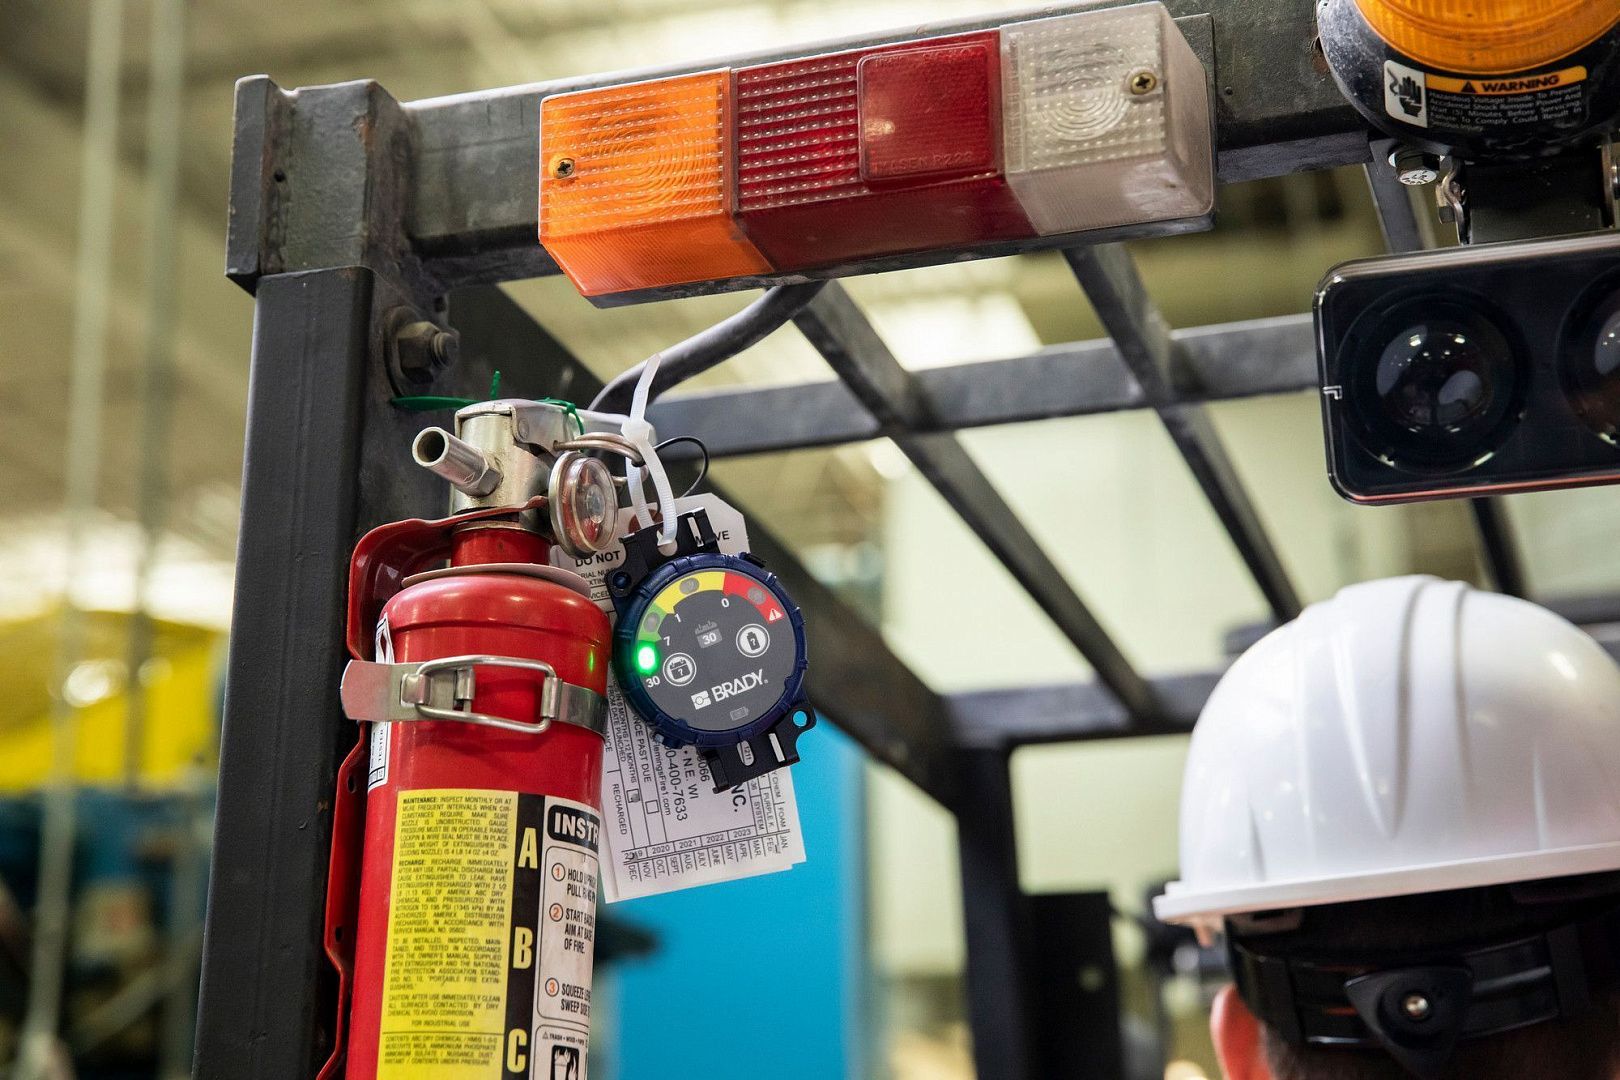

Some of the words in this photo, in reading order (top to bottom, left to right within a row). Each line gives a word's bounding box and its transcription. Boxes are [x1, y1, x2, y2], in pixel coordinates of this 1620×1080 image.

[1481, 75, 1560, 92] WARNING
[596, 550, 621, 564] NOT
[721, 598, 730, 608] 0
[674, 613, 682, 623] 1
[664, 636, 671, 646] 7
[702, 632, 717, 646] 30
[646, 675, 661, 688] 30
[711, 668, 764, 702] BRADY
[611, 707, 619, 726] DATE
[614, 726, 626, 763] PUNCHED
[637, 739, 648, 761] PAST
[744, 745, 752, 760] 1211
[626, 751, 637, 783] MONTHS
[641, 763, 652, 782] DUE
[683, 756, 696, 782] N.E.
[688, 784, 699, 799] WI
[772, 776, 782, 798] CHEM
[731, 784, 747, 812] NC.
[763, 792, 774, 820] PURPLE
[613, 783, 627, 836] RECHARGED
[754, 801, 765, 830] SYSTEM
[778, 807, 786, 828] FOAM
[706, 833, 724, 843] 2022
[733, 828, 751, 838] 2023
[517, 827, 538, 869] A
[652, 844, 670, 854] 2020
[679, 839, 697, 849] 2021
[739, 842, 747, 858] APR
[753, 839, 762, 856] MAR
[698, 851, 707, 867] JULY
[711, 849, 720, 865] JUNE
[725, 845, 734, 860] MAY
[642, 861, 651, 878] NOV
[655, 859, 665, 874] OCT
[670, 856, 679, 873] SEPT
[684, 853, 693, 870] AUG
[567, 868, 583, 883] HOLD
[628, 864, 638, 880] DEC
[566, 883, 582, 898] PULL
[565, 908, 583, 921] START
[564, 923, 576, 936] AIM
[576, 926, 584, 938] AT
[512, 926, 533, 969] B
[563, 938, 573, 950] OF
[561, 983, 584, 1000] SQUEEZE
[560, 998, 580, 1014] SWEEP
[506, 1028, 527, 1073] C
